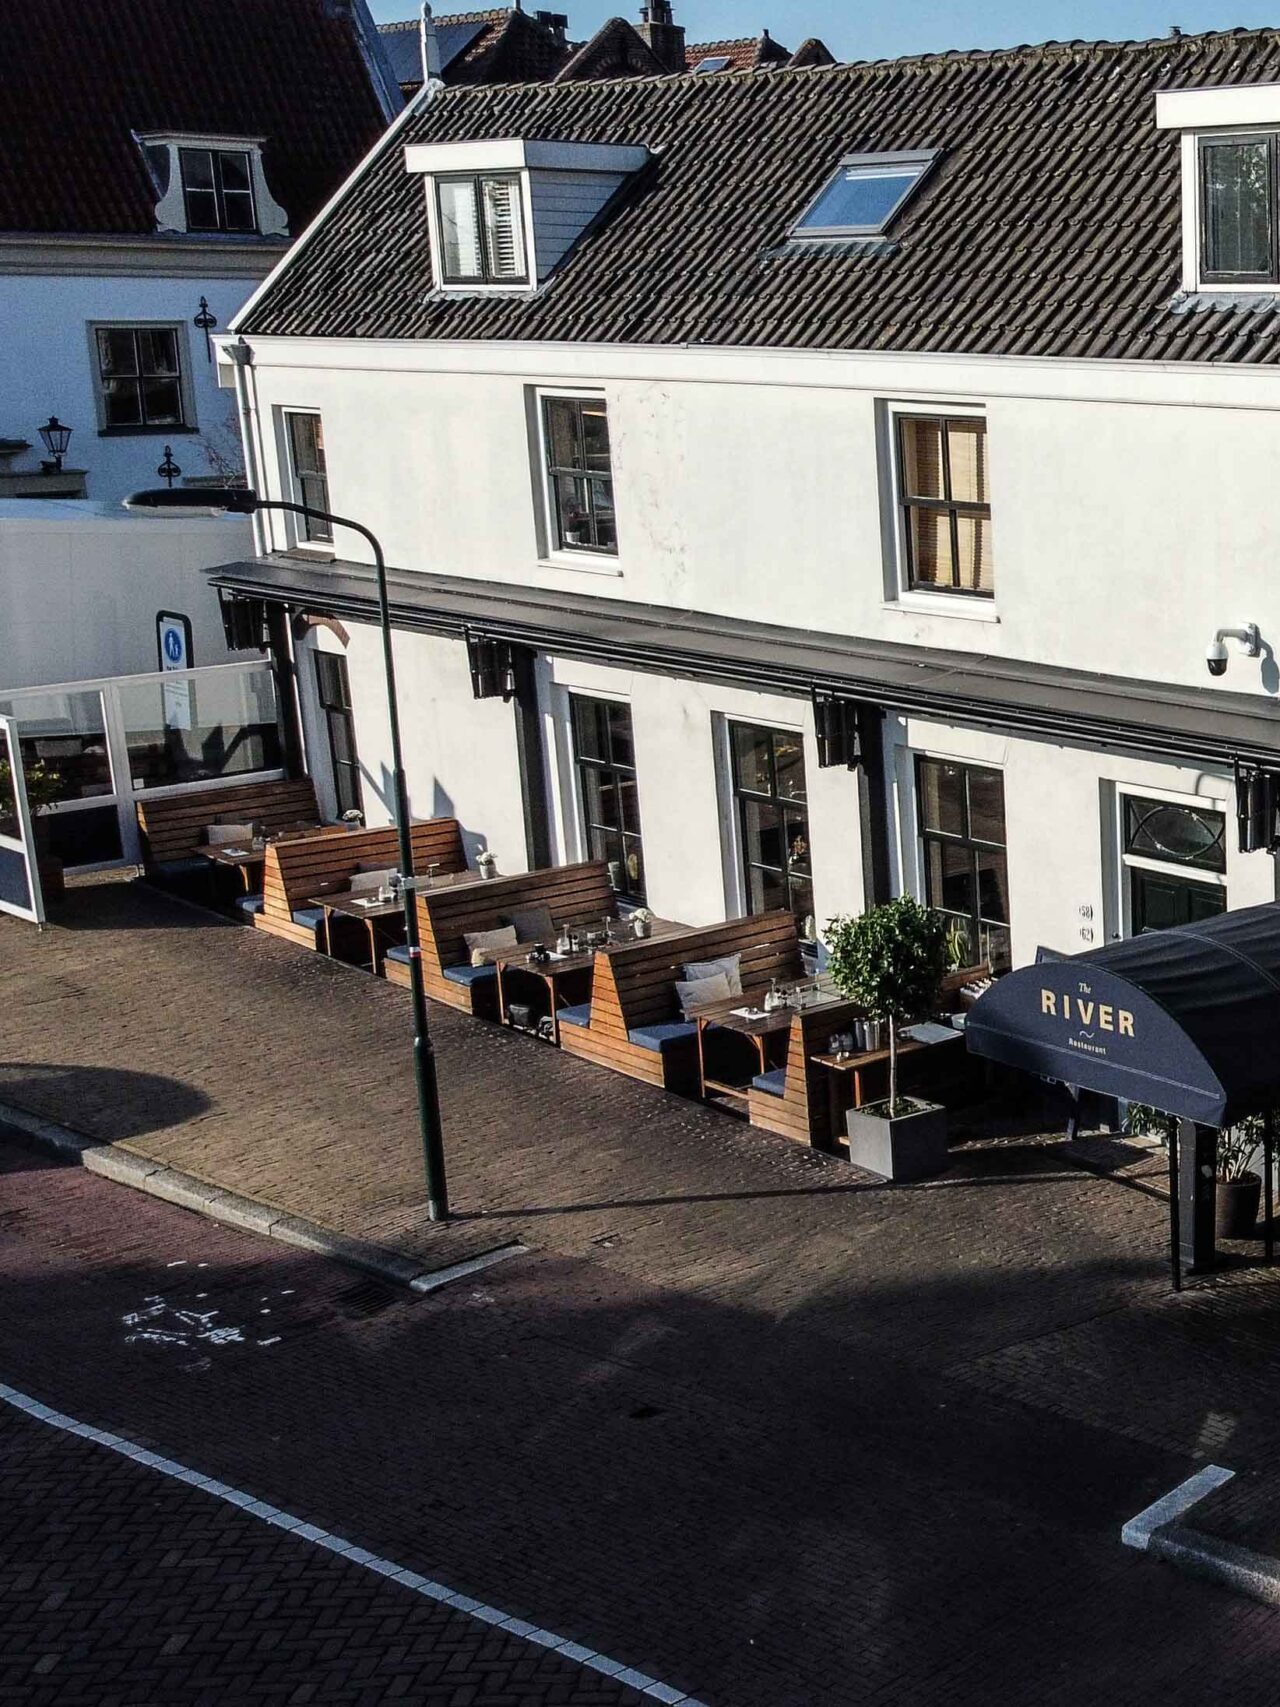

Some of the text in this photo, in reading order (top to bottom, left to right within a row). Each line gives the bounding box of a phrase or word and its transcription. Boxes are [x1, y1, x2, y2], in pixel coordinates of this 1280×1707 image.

[1079, 982, 1091, 994] The
[1041, 988, 1135, 1037] RIVER
[1068, 1037, 1107, 1055] Restaurant
